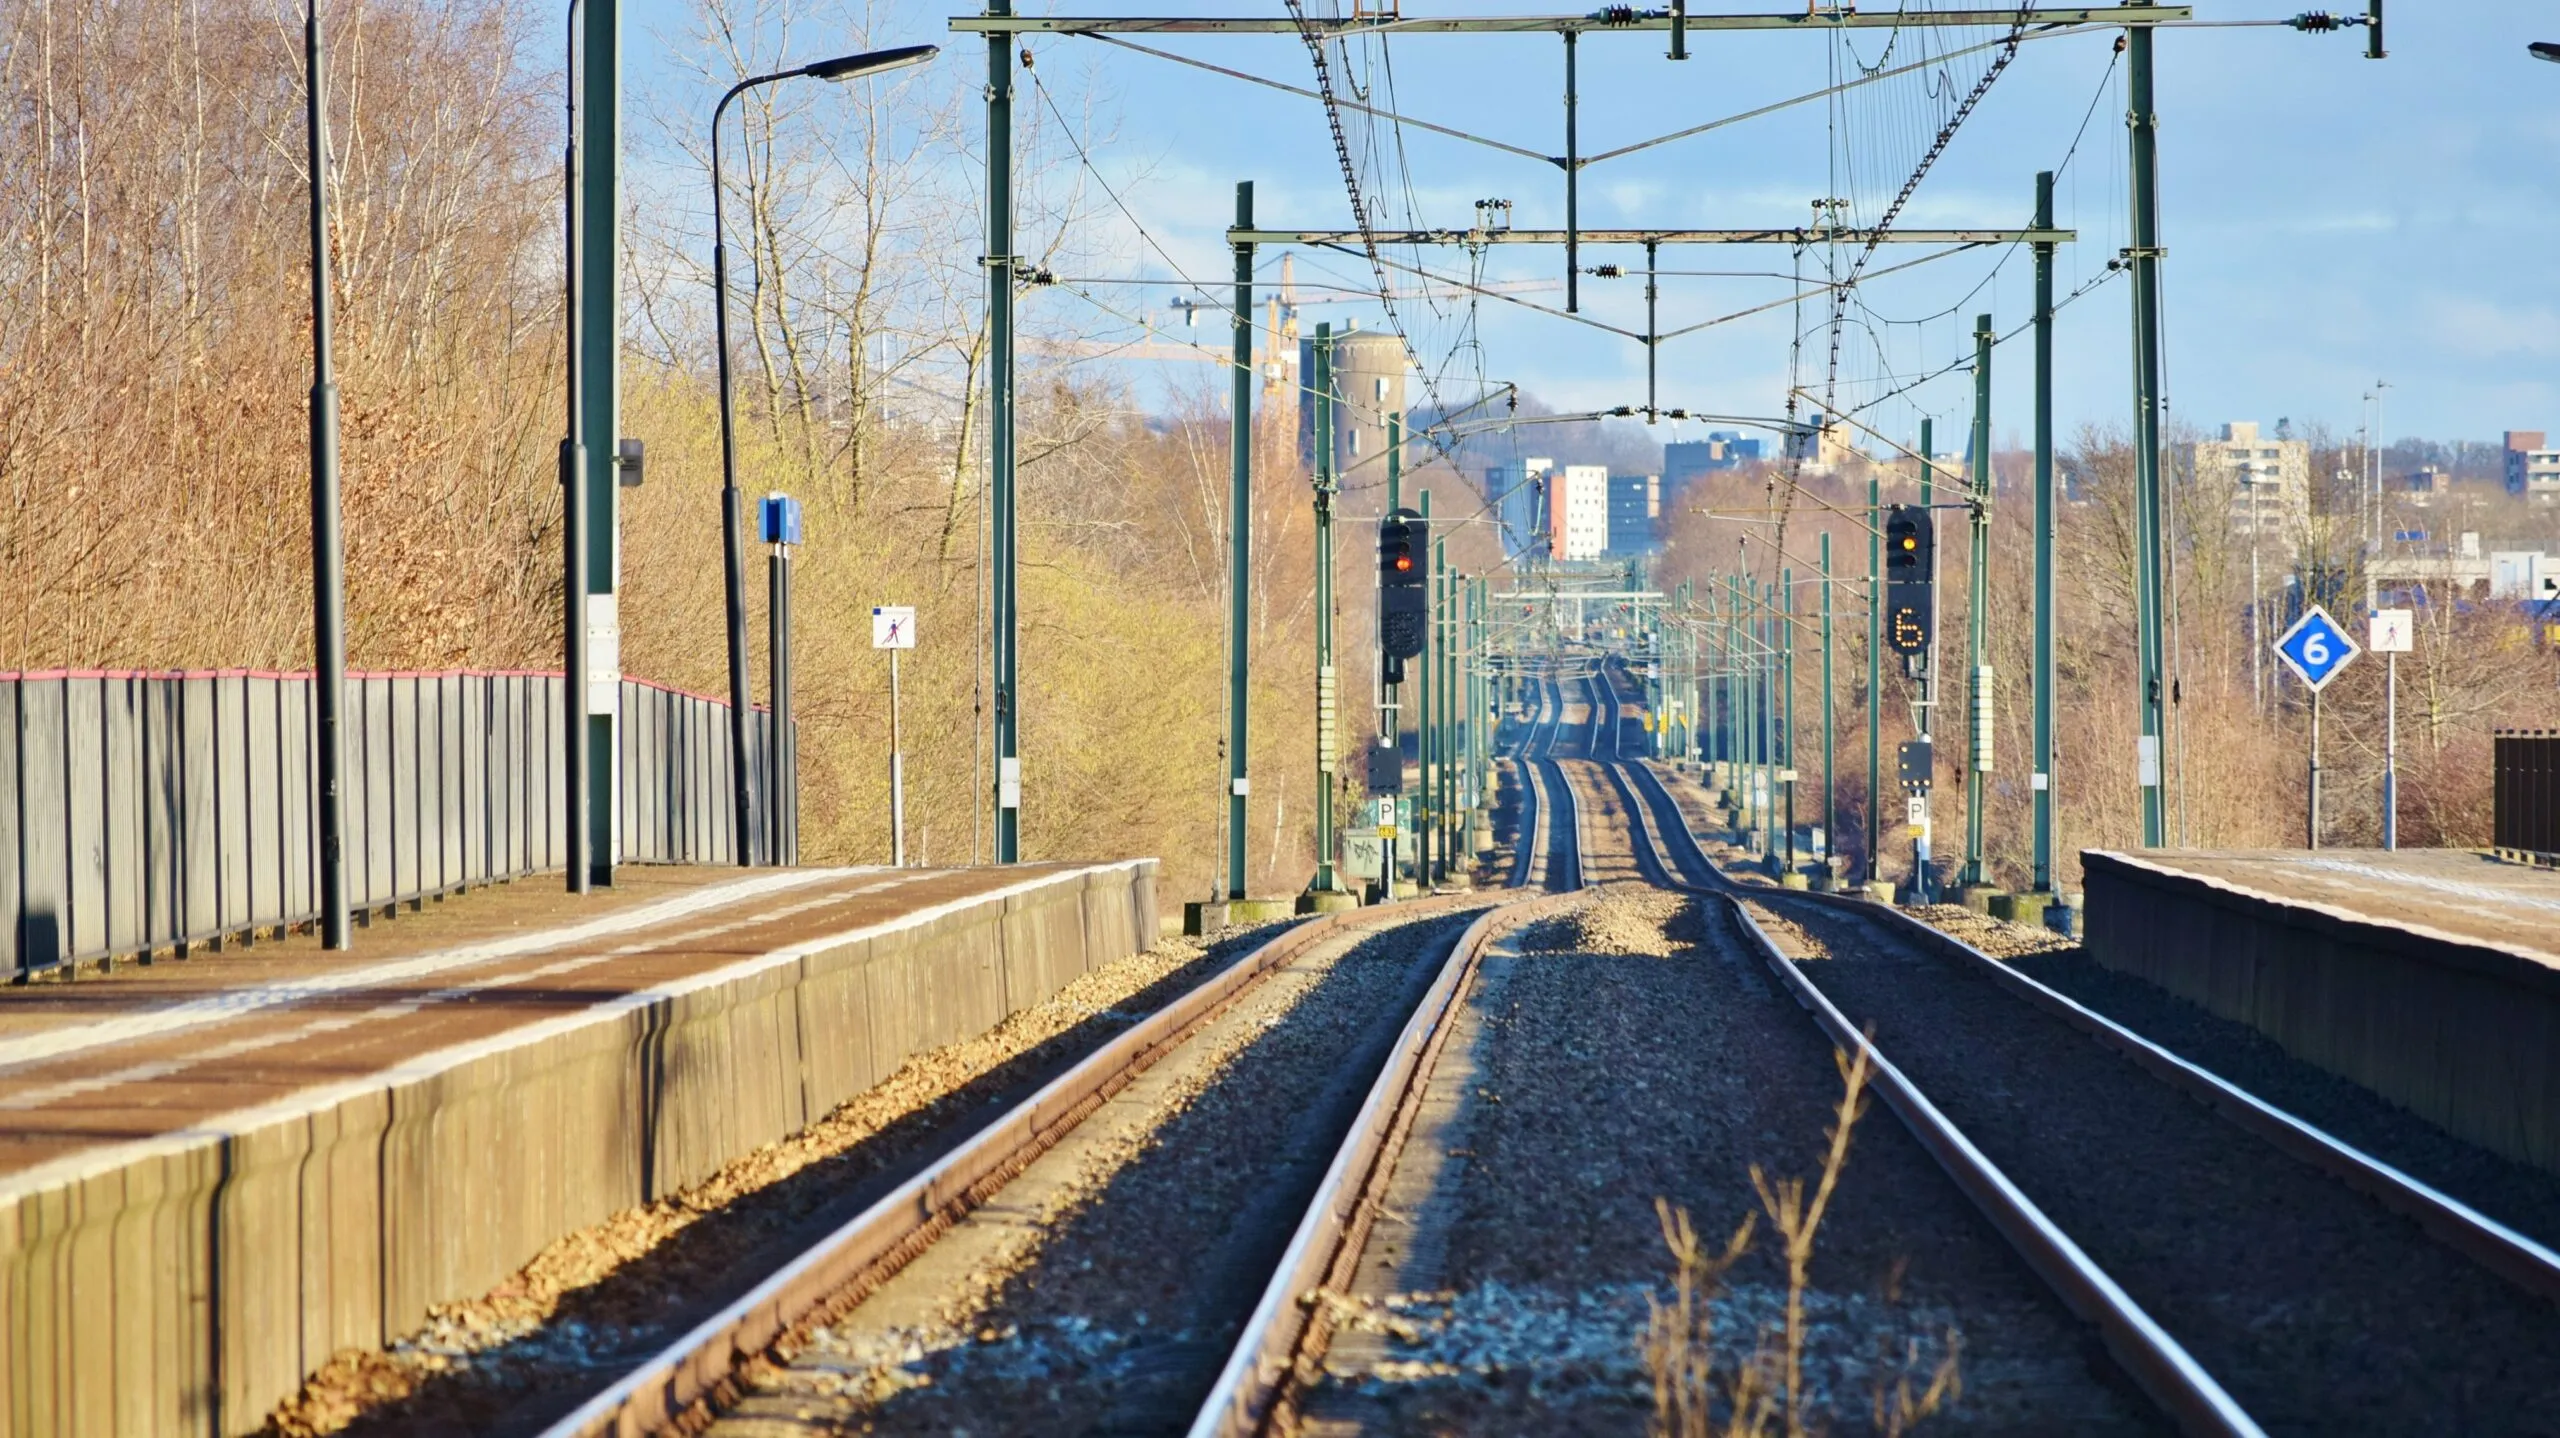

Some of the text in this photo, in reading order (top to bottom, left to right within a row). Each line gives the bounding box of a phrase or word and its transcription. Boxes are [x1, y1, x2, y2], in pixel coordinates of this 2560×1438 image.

[1896, 608, 1922, 647] 6
[2303, 632, 2329, 665] 6
[1381, 803, 1392, 820] P
[1911, 803, 1922, 820] P
